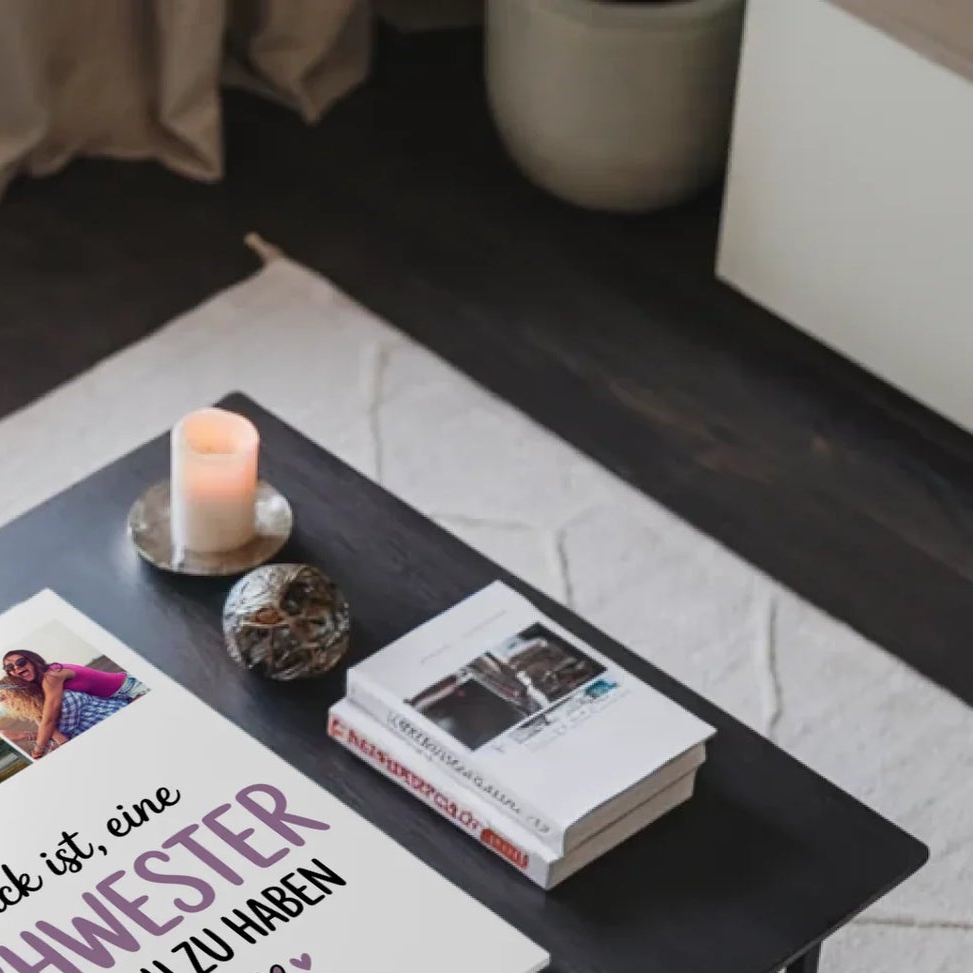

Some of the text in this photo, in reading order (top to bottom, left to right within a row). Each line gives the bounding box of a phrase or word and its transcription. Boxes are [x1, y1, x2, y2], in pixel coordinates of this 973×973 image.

[39, 831, 108, 876] ist,
[106, 786, 181, 838] eine
[220, 858, 347, 945] HABEN
